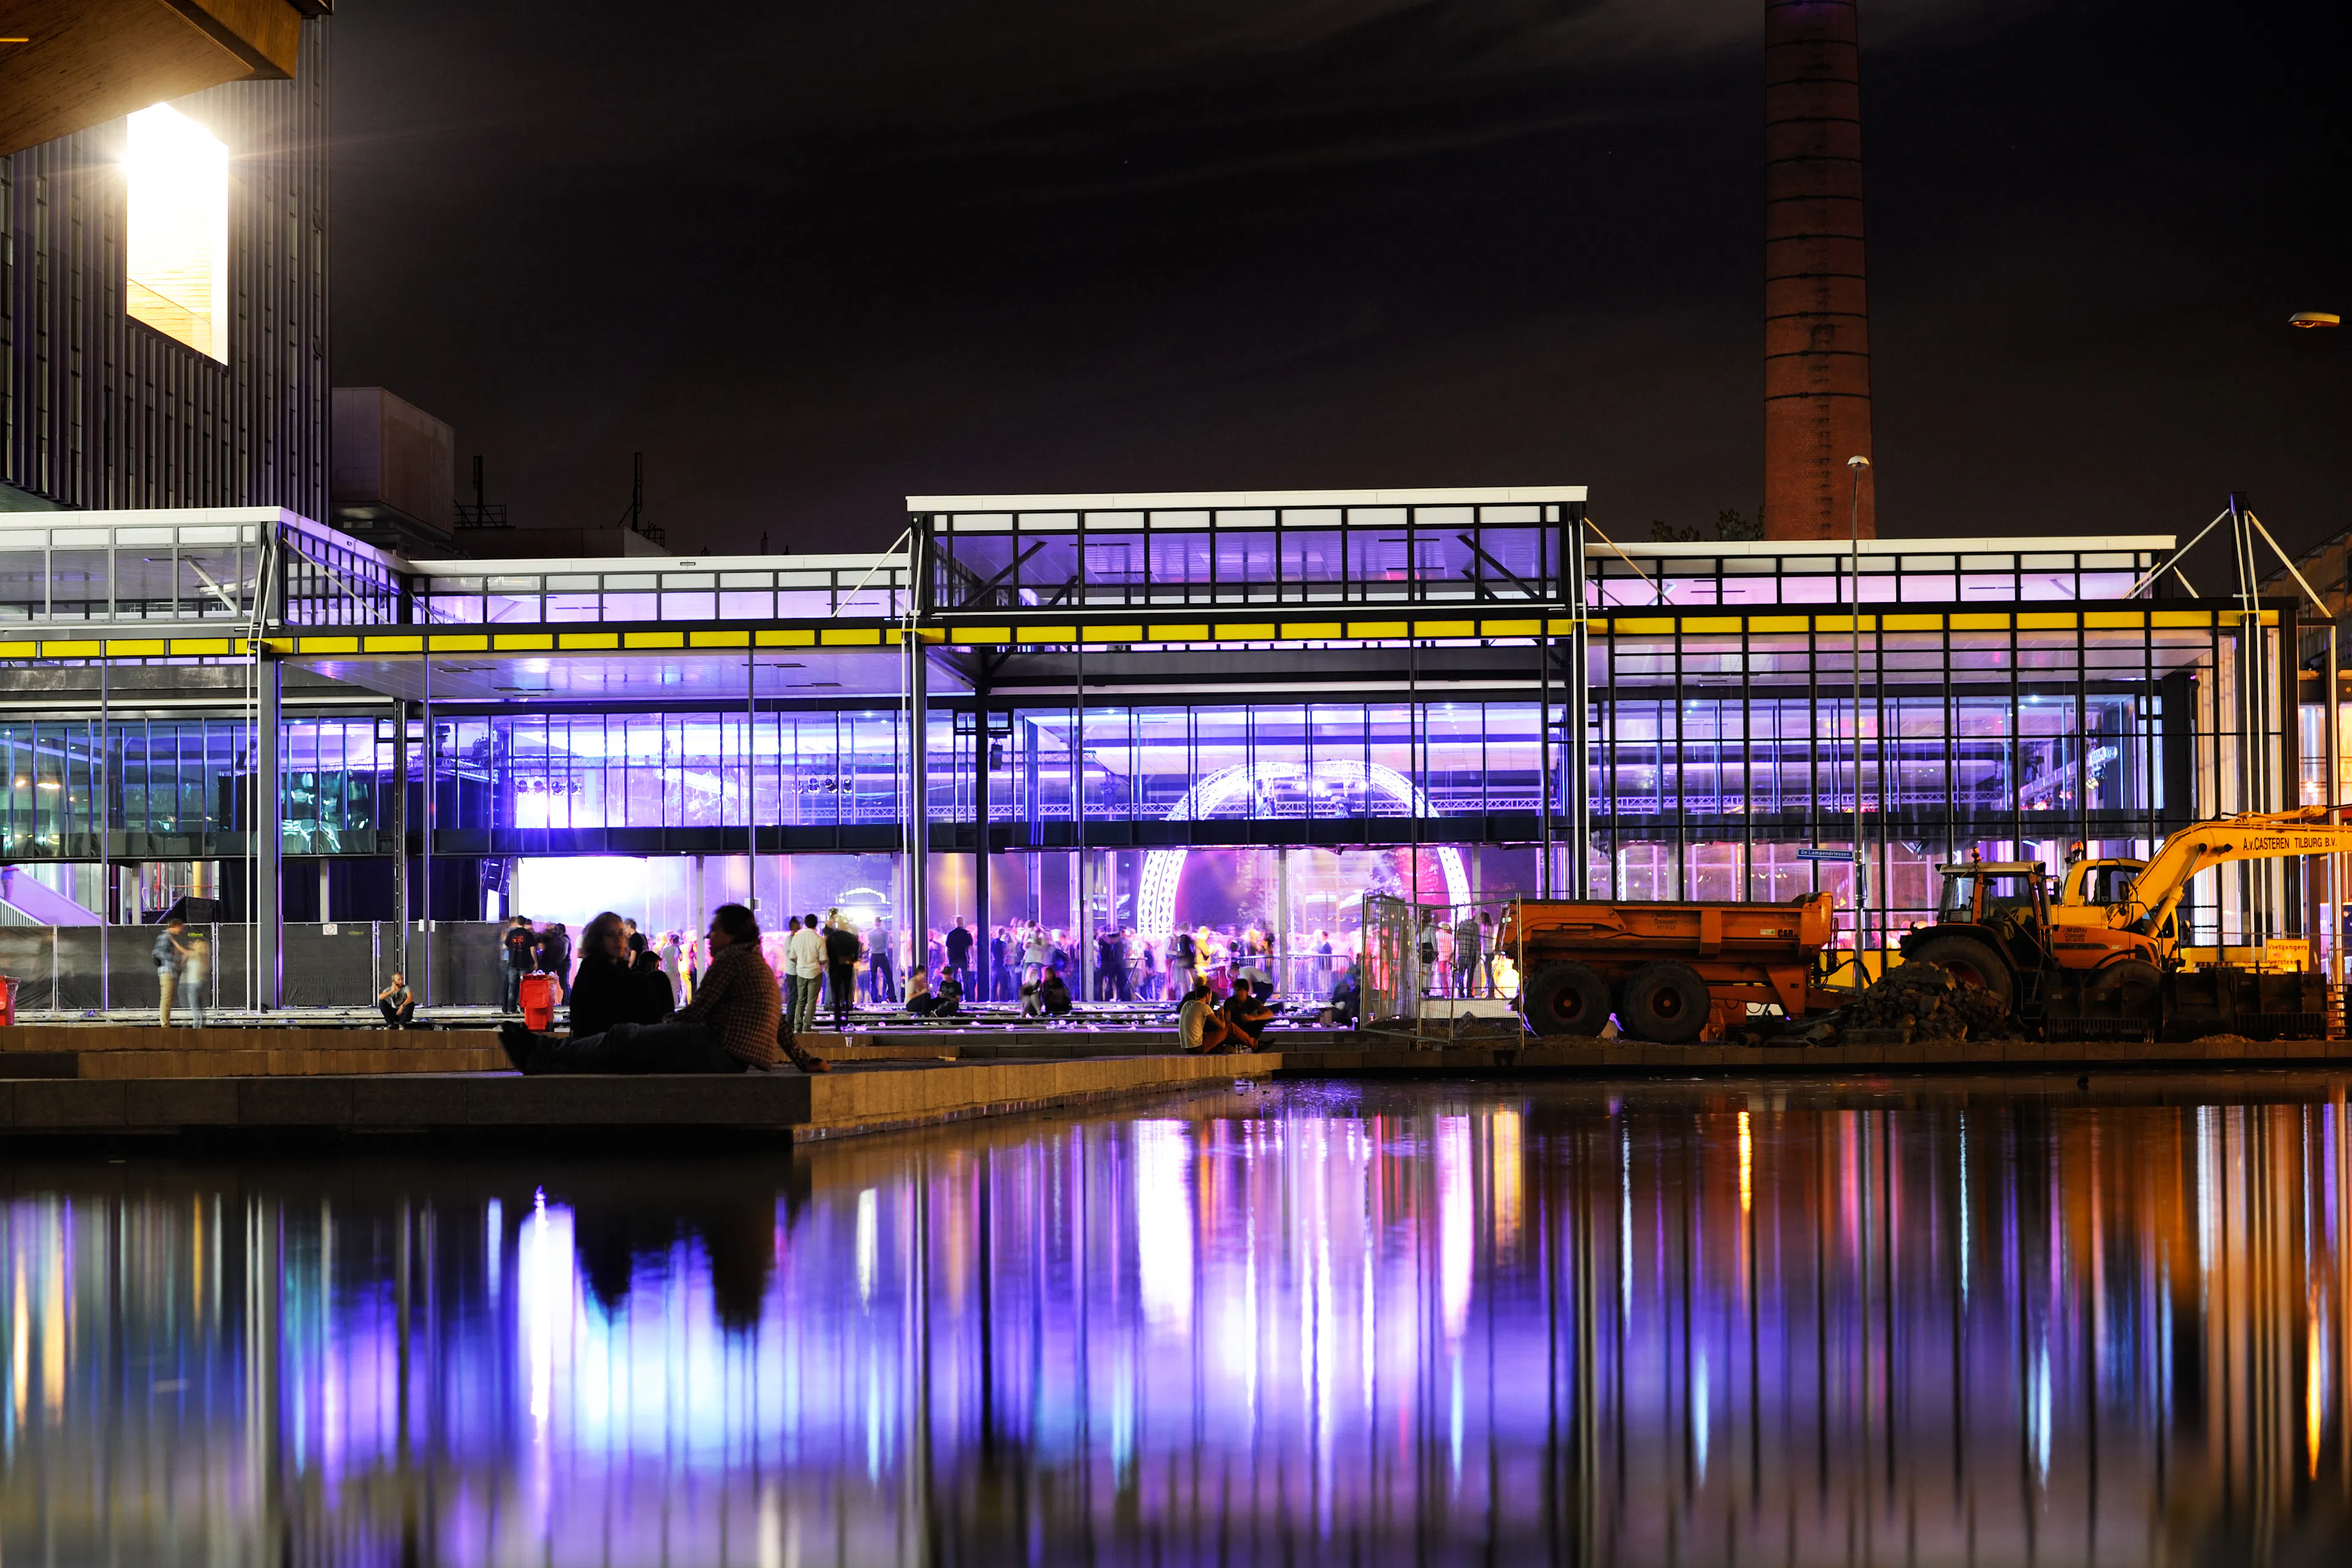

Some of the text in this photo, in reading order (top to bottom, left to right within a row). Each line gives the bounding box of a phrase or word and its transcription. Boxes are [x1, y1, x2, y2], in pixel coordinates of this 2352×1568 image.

[2294, 837, 2323, 848] TILBURG
[2325, 837, 2337, 846] B.V.
[1777, 929, 1793, 938] CAR
